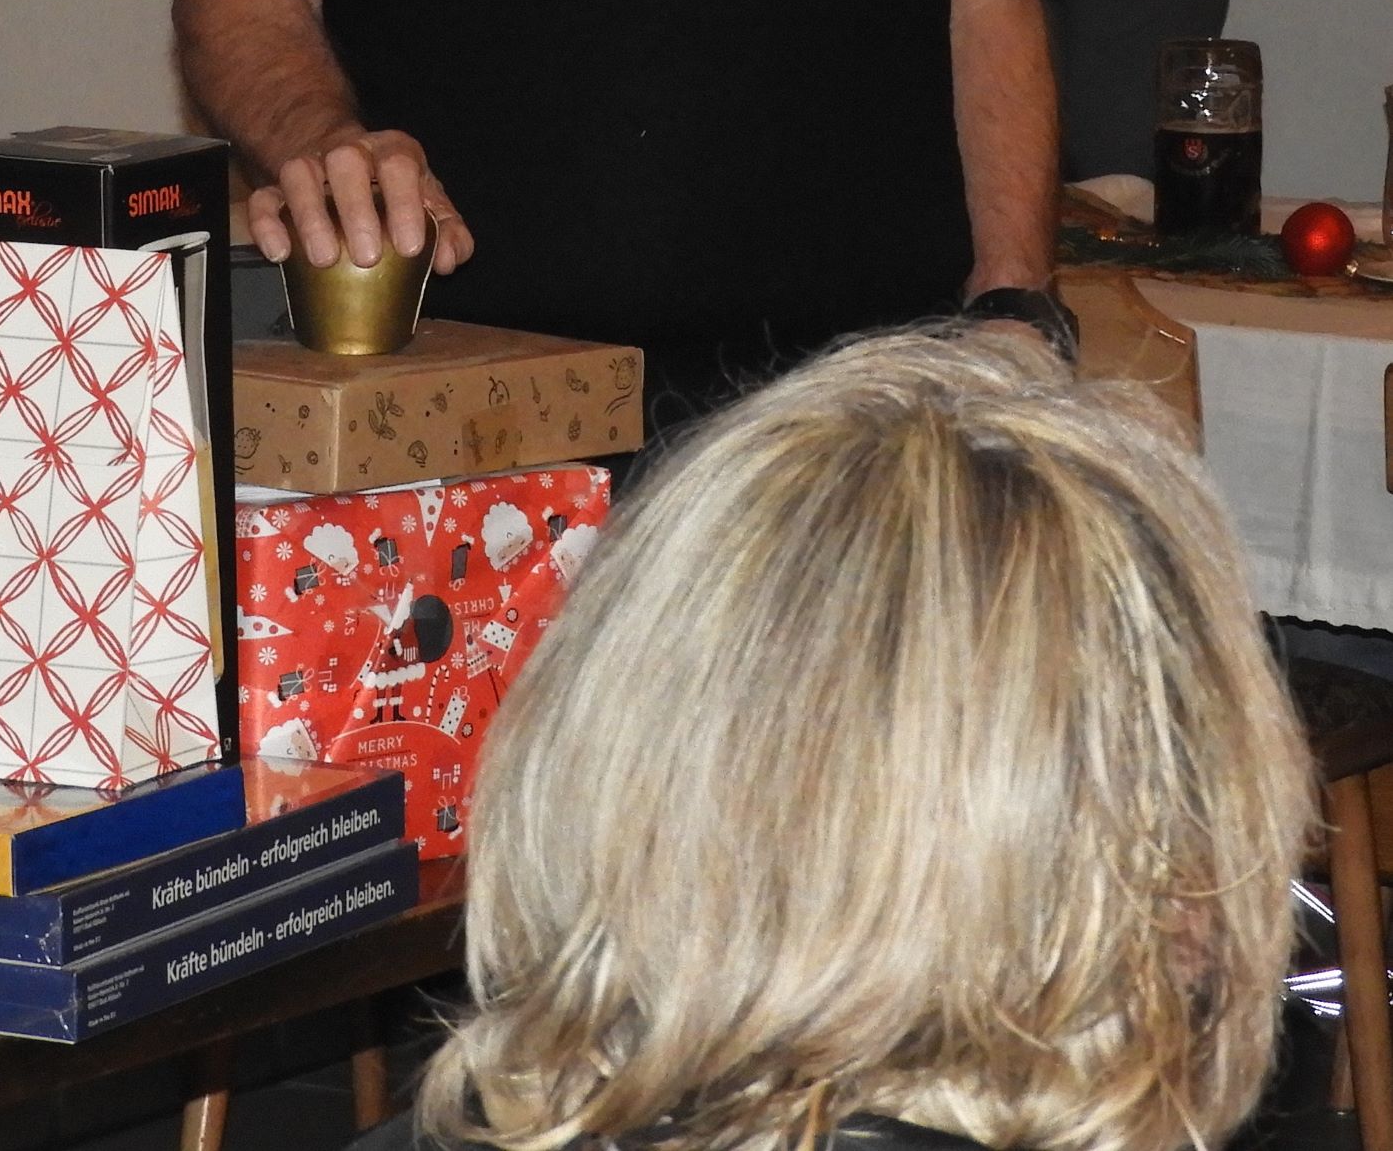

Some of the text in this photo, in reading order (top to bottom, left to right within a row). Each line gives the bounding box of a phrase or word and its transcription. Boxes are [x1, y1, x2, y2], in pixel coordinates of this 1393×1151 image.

[128, 183, 180, 218] SIMAX
[455, 597, 495, 615] CHRIS
[358, 734, 405, 755] MERRY
[153, 877, 193, 910] Kräfte
[195, 853, 249, 894] bündeln
[261, 823, 329, 868] erfolgreich
[332, 808, 381, 841] bleiben.
[167, 951, 208, 985] Kräfte
[211, 927, 264, 968] bündeln
[275, 895, 343, 941] erfolgreich
[346, 880, 395, 913] bleiben.
